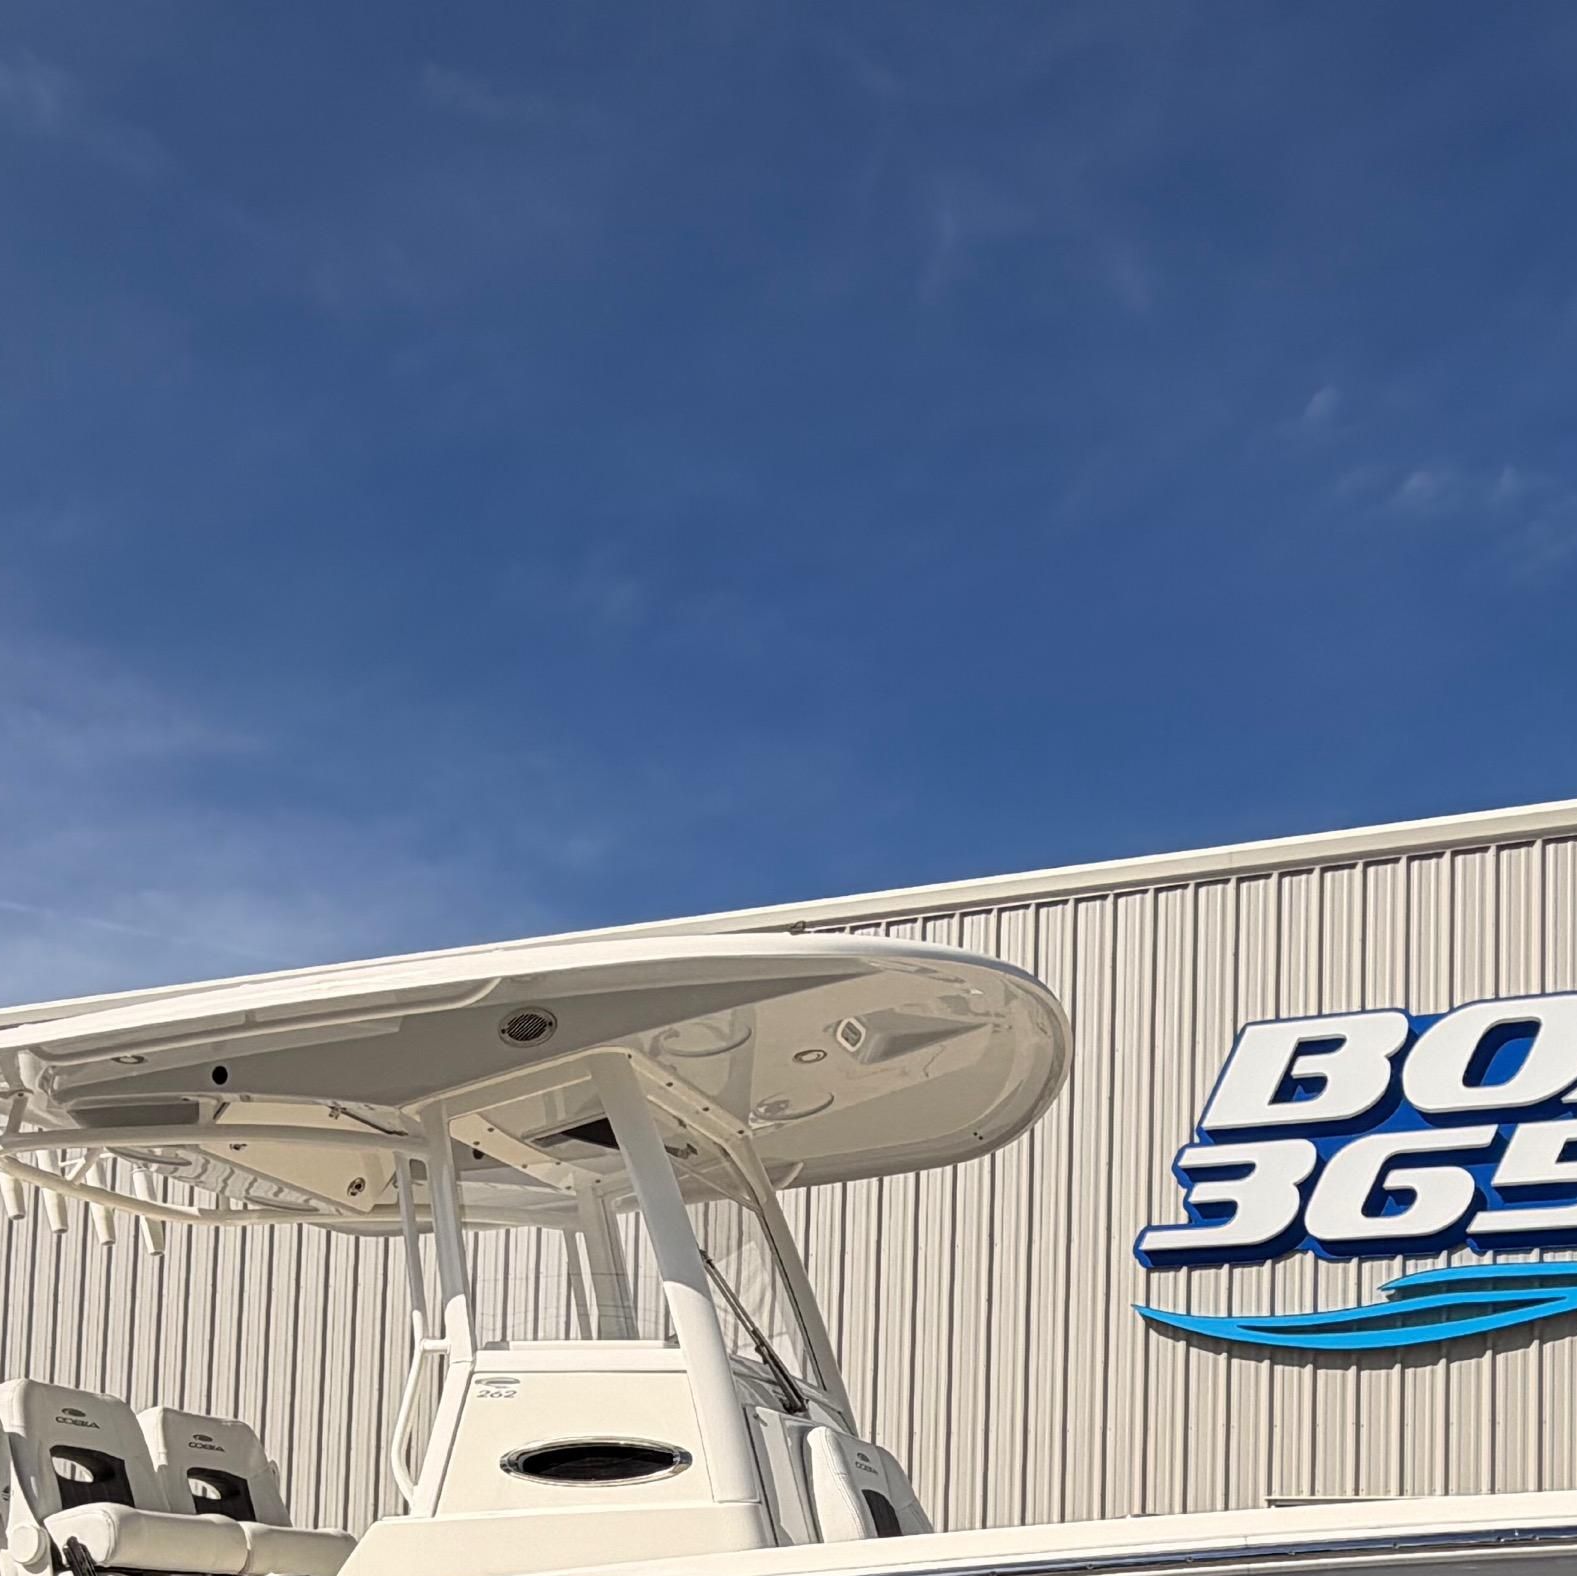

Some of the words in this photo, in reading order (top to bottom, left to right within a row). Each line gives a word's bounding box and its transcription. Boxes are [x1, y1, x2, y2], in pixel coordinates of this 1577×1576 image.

[476, 1389, 517, 1398] 262
[56, 1417, 100, 1429] COBIA
[189, 1442, 225, 1452] COBIA
